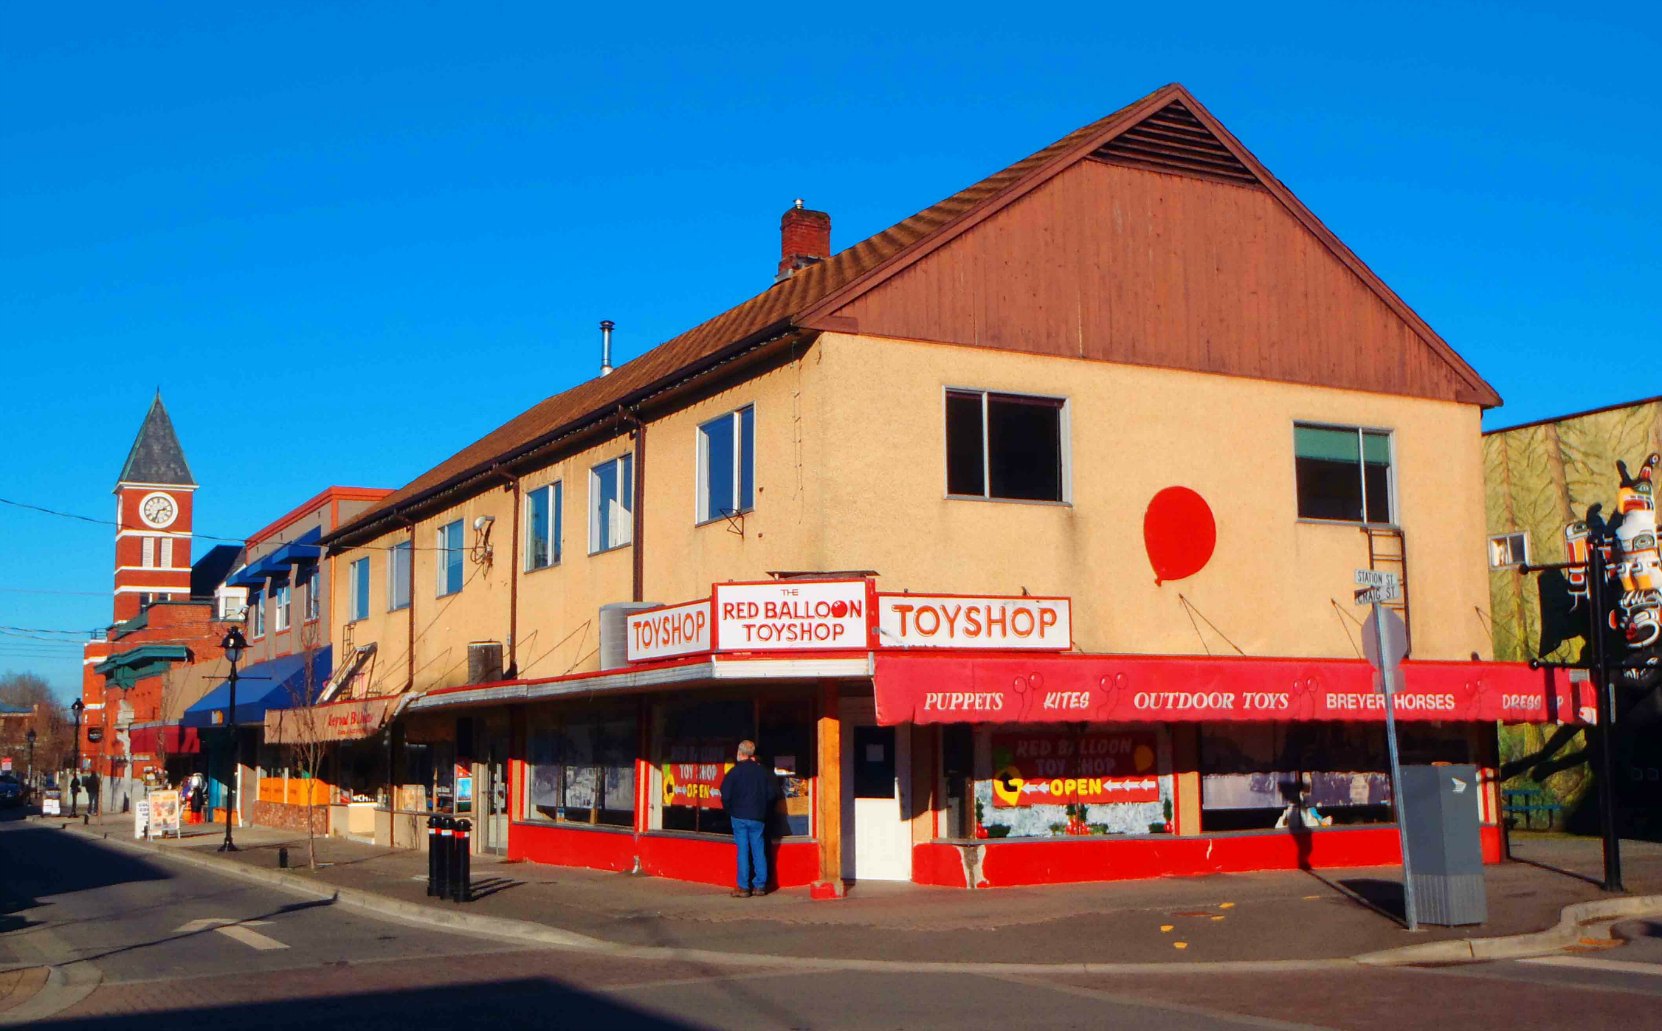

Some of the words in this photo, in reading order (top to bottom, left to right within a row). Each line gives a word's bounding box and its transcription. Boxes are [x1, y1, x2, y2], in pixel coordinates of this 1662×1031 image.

[1357, 571, 1382, 584] STATION
[1386, 574, 1393, 585] ST
[780, 588, 799, 597] THE
[1386, 586, 1395, 599] ST
[723, 601, 759, 620] RED
[764, 600, 862, 620] BALLOON
[633, 610, 706, 652] TOYSHOP
[891, 604, 1058, 640] TOYSHOP
[743, 622, 845, 642] TOYSHOP
[924, 692, 1004, 711] PUPPETS
[1043, 691, 1091, 710] KITES
[1134, 692, 1235, 710] OUTDOOR
[1242, 692, 1290, 710] TOYS
[1326, 693, 1386, 710] BREYER
[1394, 693, 1456, 711] HORSES
[1502, 694, 1542, 710] DRESS
[680, 764, 693, 780] TOY
[1035, 758, 1067, 776] TOY
[1050, 778, 1102, 796] OPEN
